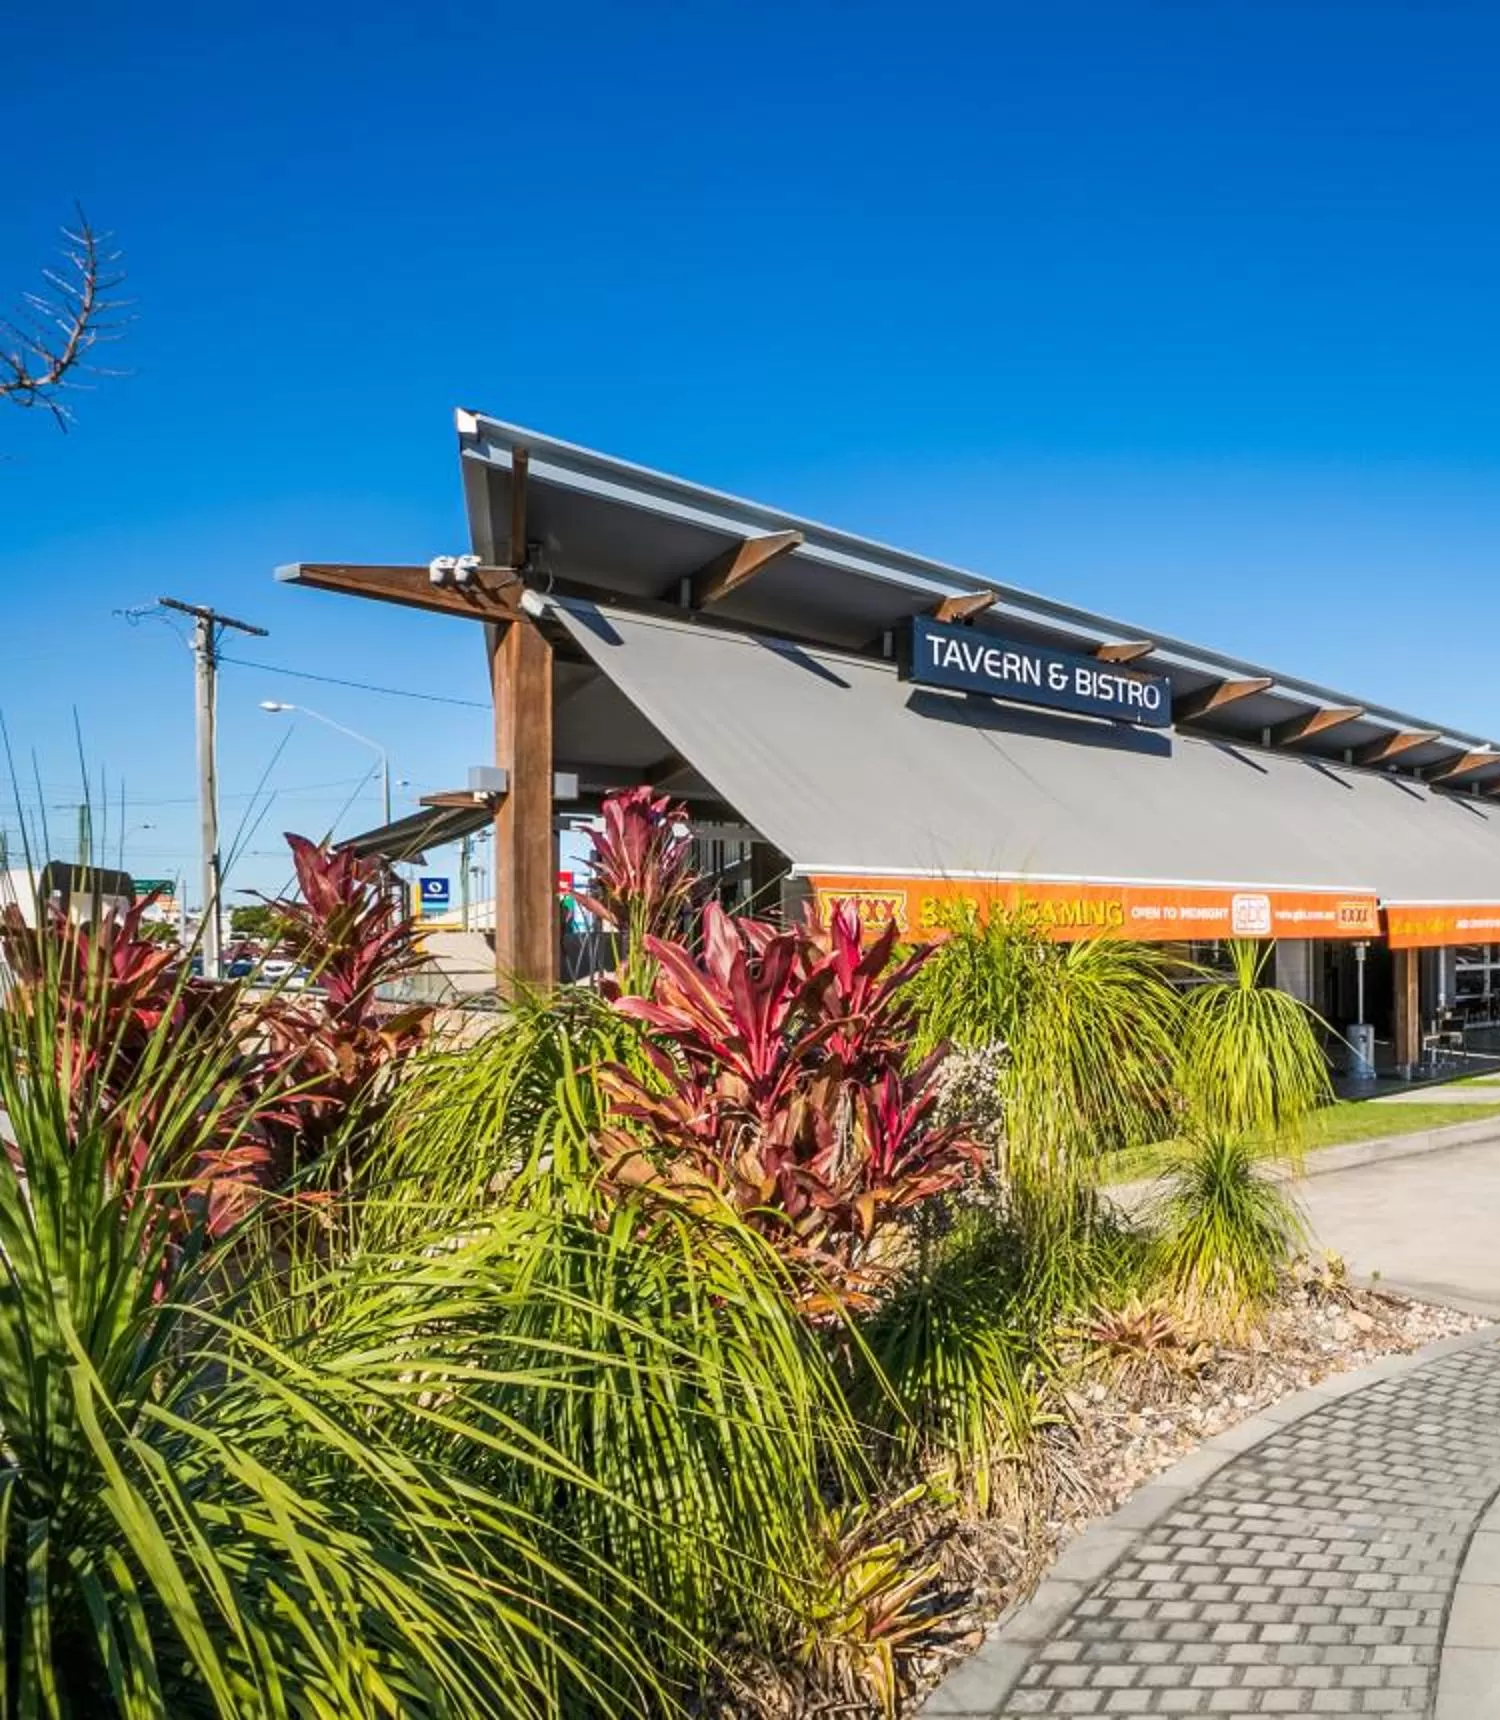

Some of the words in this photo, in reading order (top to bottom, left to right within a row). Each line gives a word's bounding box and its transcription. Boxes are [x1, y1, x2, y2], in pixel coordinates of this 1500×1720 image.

[925, 633, 1041, 687] TAVERN
[1047, 663, 1069, 691] &
[1074, 668, 1161, 710] BISTRO
[1019, 898, 1125, 926] GAMING
